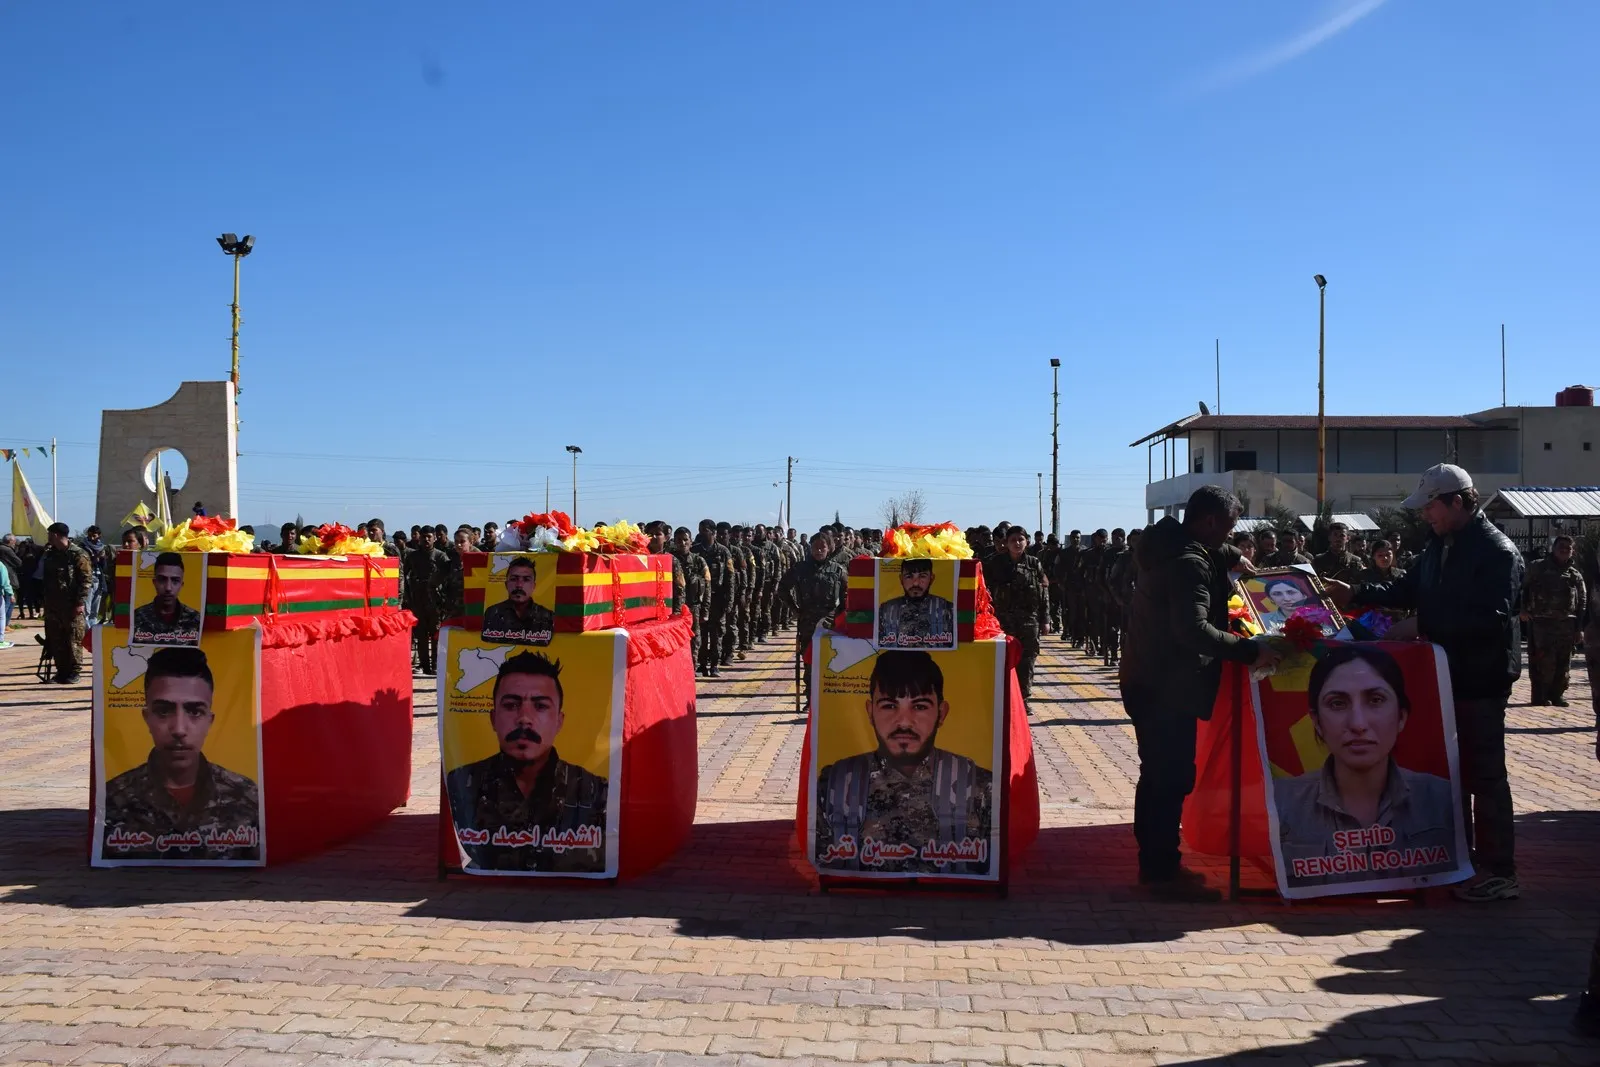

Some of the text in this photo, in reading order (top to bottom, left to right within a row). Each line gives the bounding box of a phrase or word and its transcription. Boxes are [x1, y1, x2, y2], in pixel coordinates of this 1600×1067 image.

[134, 629, 154, 641] حميد
[154, 631, 175, 642] عيسى
[482, 628, 504, 638] محمد
[526, 629, 552, 642] الشهيد
[880, 631, 953, 646] الشهيد حسين تمر
[106, 824, 258, 852] الشهيد عيسى حميد
[542, 823, 602, 854] الشهيد
[1333, 823, 1396, 851] ŞEHÎD
[818, 834, 988, 867] الشهيد حسين تمر
[1292, 847, 1450, 878] RENGÎN ROJAVA
